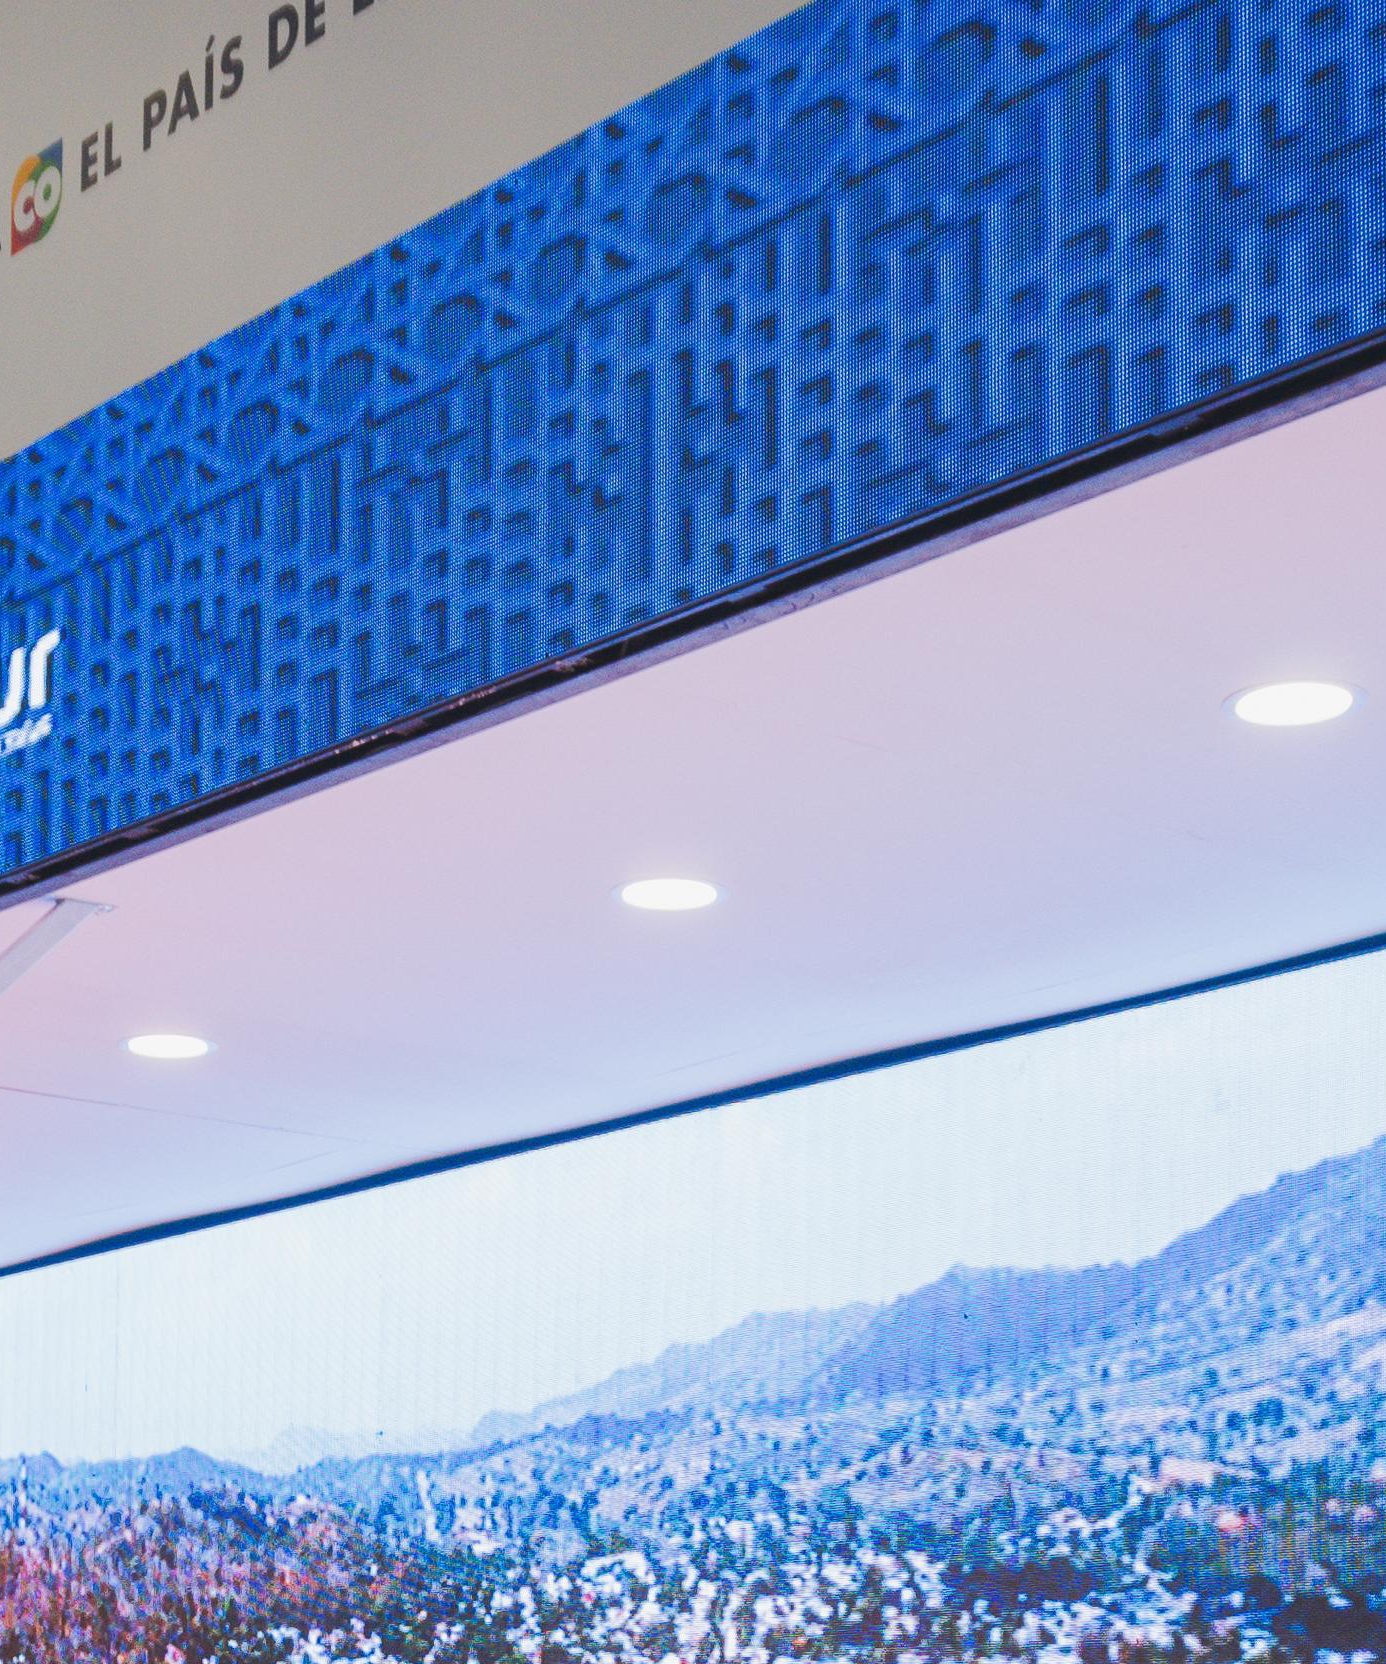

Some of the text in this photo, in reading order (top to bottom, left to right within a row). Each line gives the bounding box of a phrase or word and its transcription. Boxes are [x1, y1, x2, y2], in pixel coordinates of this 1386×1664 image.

[79, 122, 122, 192] EL
[141, 35, 244, 152] PAÍS
[268, 0, 326, 71] DE
